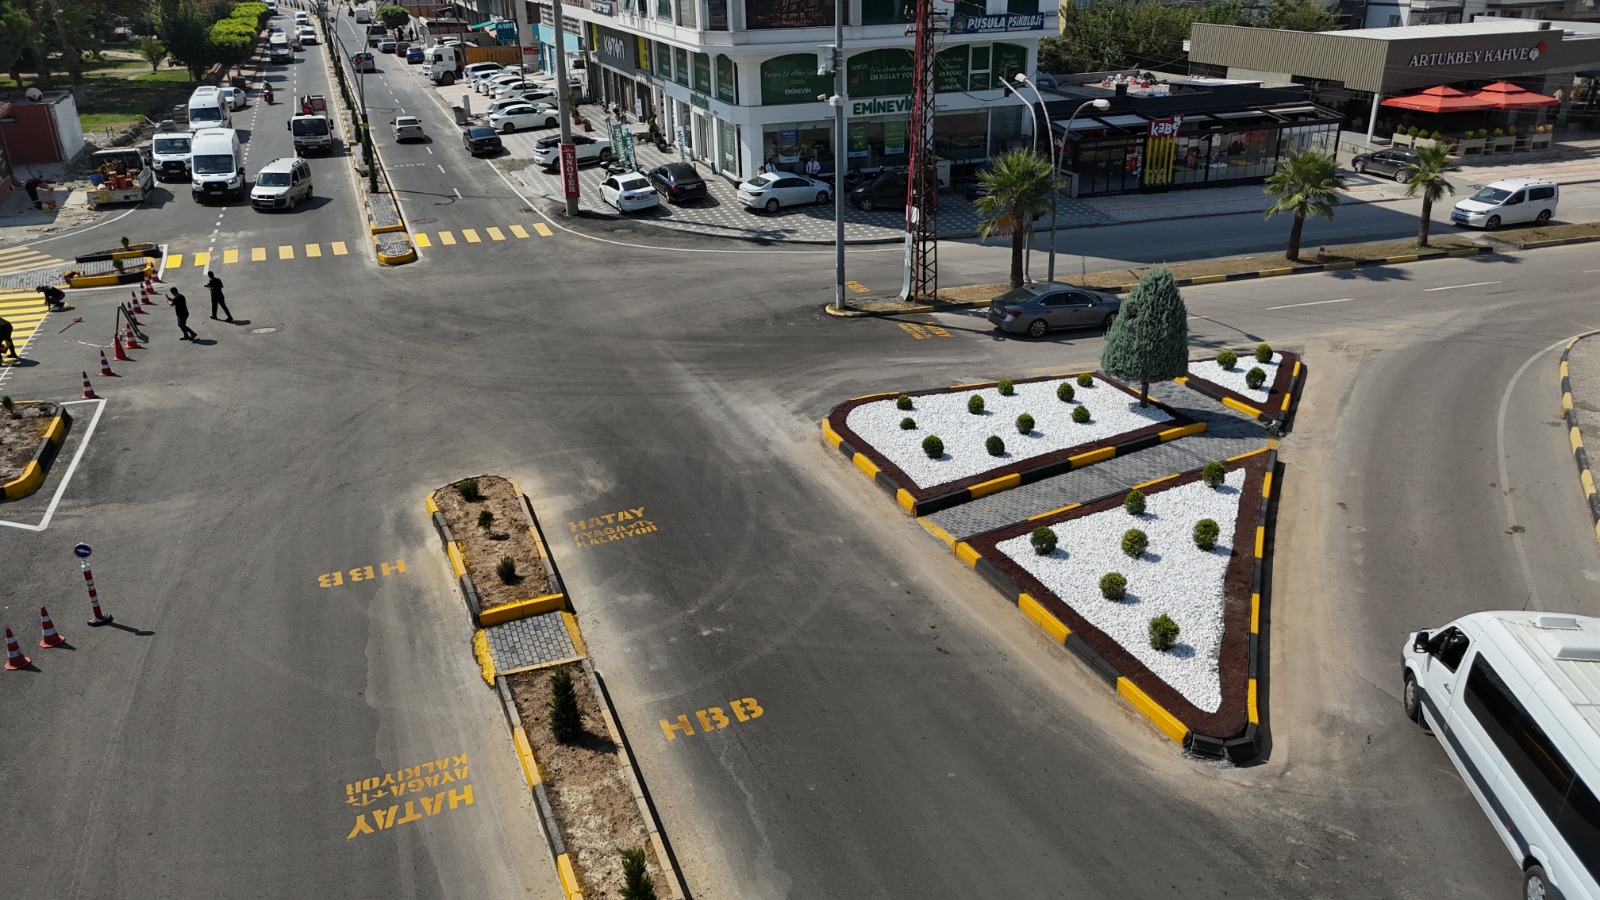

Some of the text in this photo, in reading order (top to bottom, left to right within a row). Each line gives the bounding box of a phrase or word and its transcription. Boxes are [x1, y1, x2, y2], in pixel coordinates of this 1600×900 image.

[967, 16, 1005, 30] PUSULA
[1409, 48, 1529, 67] ARTUKBEY KAHVE
[568, 506, 644, 533] HATAY
[317, 559, 408, 588] HBB
[659, 697, 764, 741] HBB
[346, 752, 467, 796] KALKIYOR
[346, 783, 474, 840] HATAY
